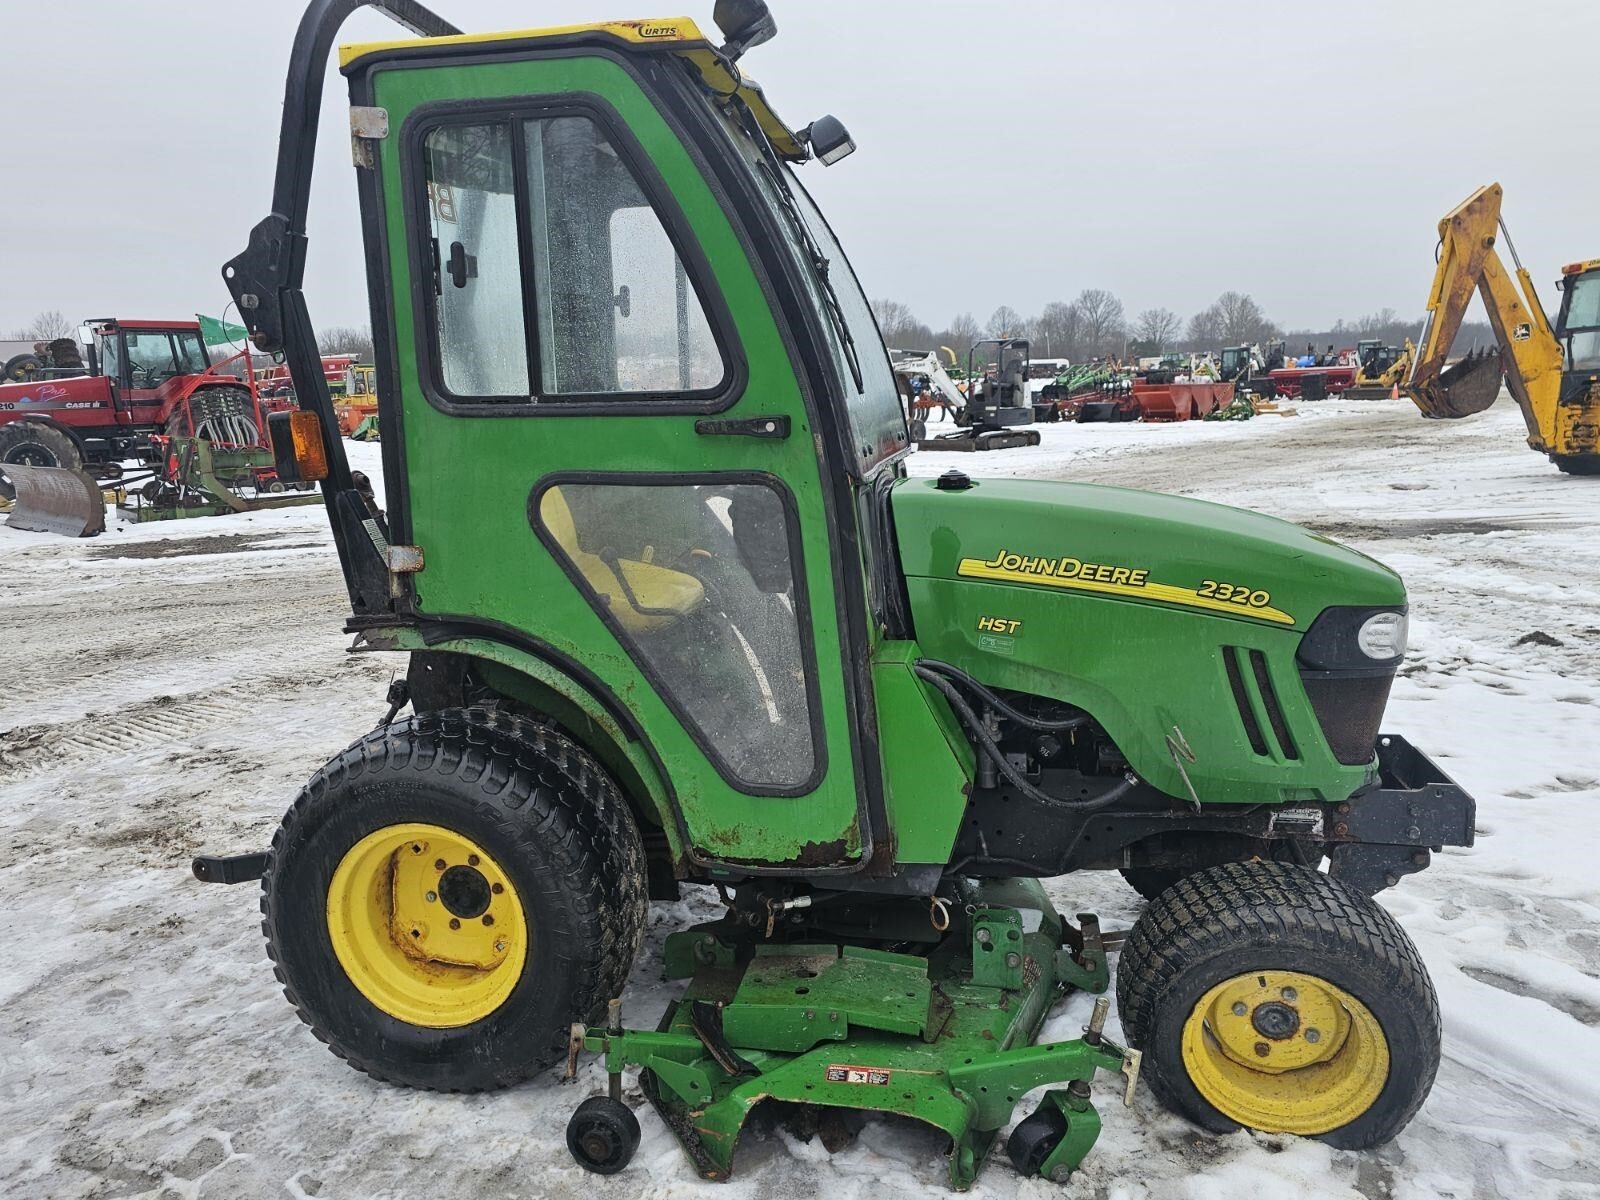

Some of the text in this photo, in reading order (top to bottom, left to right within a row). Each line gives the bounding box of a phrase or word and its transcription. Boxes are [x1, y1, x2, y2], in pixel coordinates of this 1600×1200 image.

[638, 26, 677, 38] CURTIS
[985, 549, 1149, 587] JOHN DEERE
[1196, 580, 1271, 608] 2320
[977, 615, 1022, 634] HST
